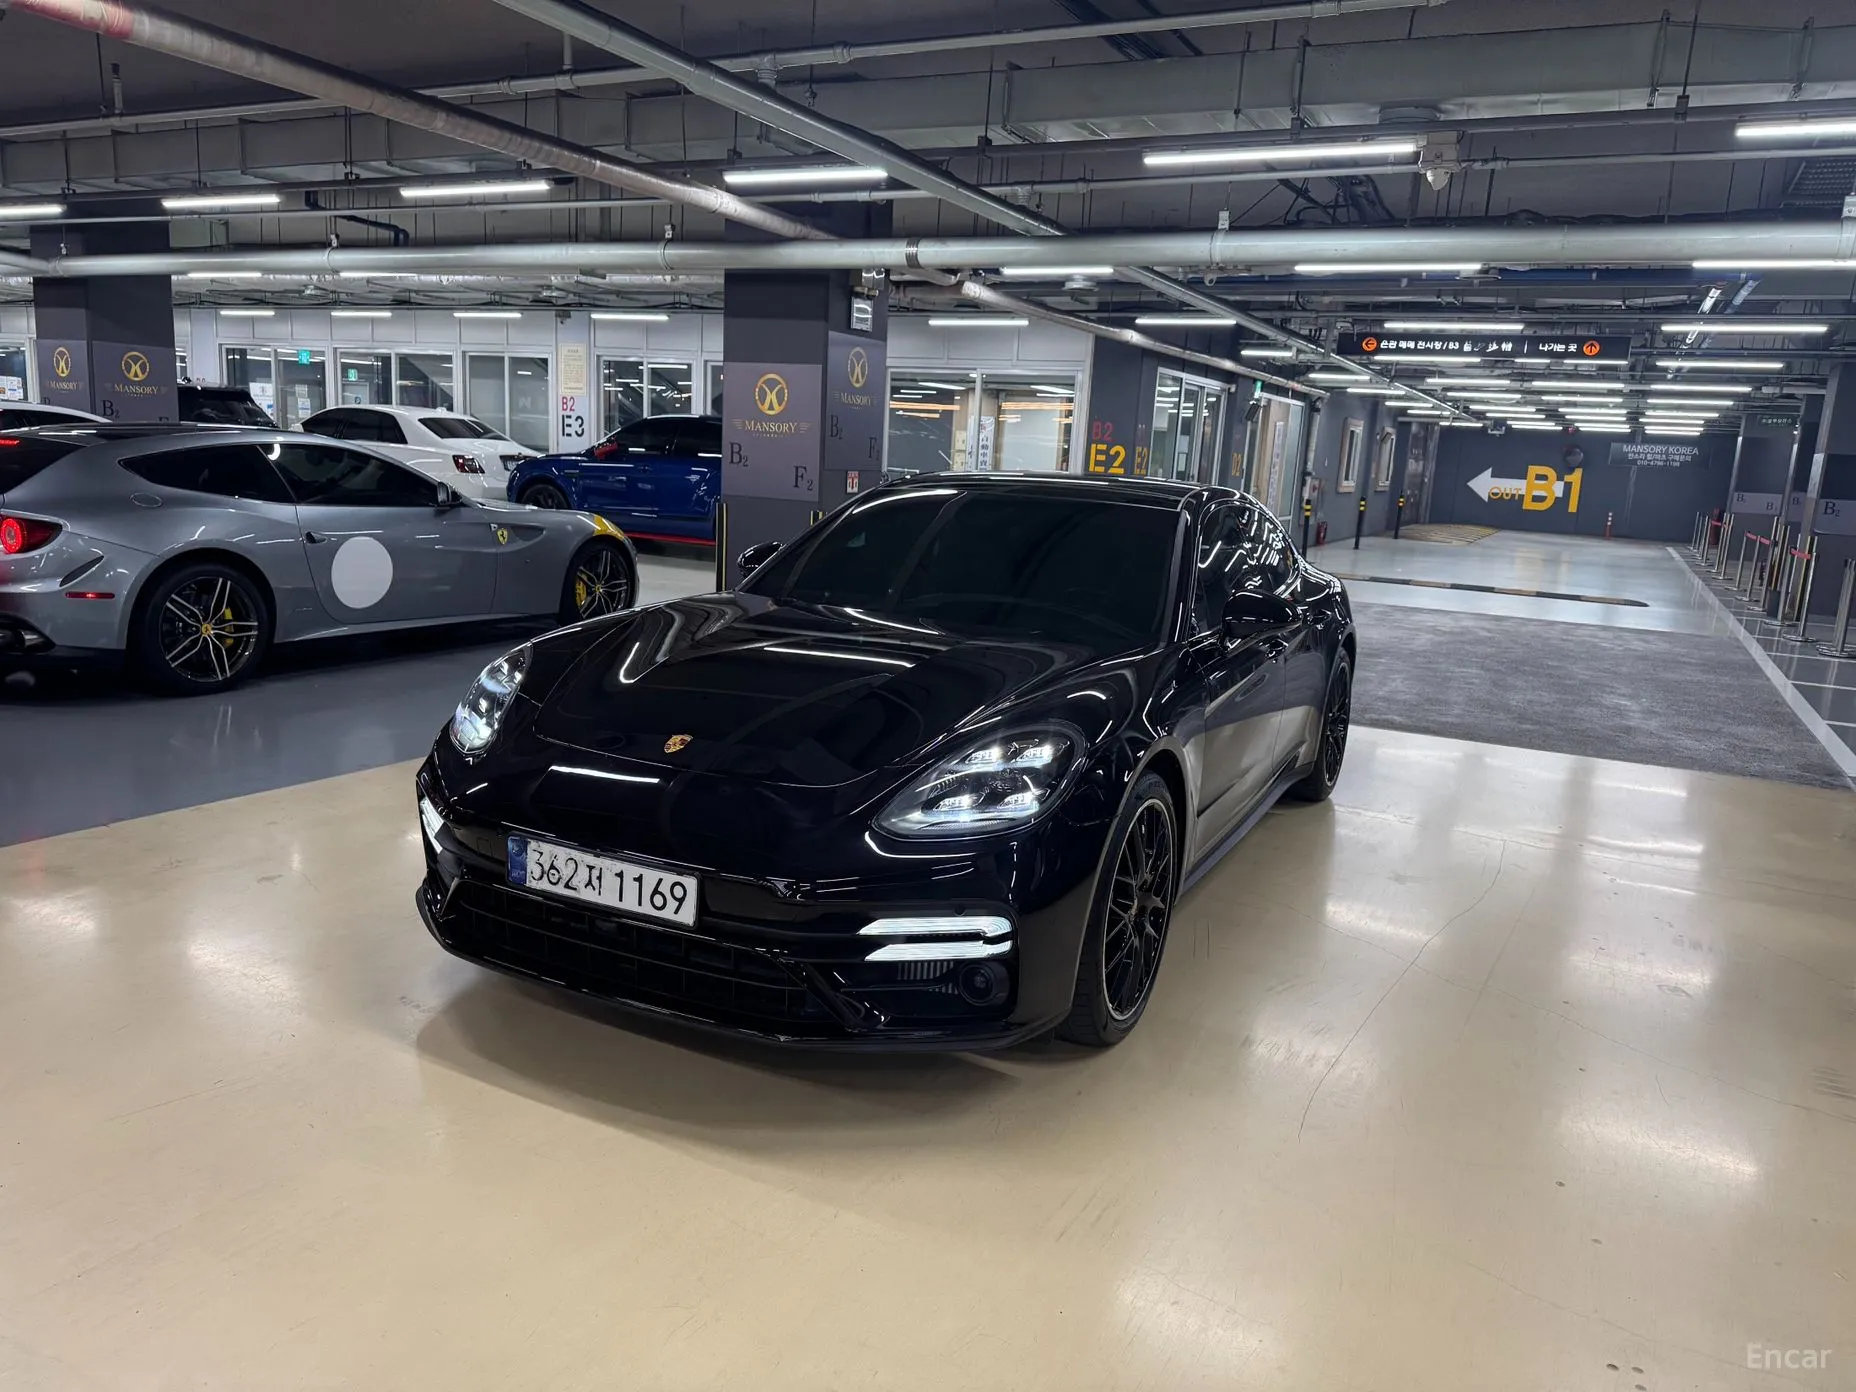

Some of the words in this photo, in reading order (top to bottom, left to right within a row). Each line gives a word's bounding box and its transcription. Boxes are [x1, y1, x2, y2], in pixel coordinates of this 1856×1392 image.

[1417, 340, 1442, 350] 전시장
[1539, 342, 1566, 352] 나가는
[1567, 343, 1578, 352] 곳
[49, 380, 79, 391] MANSORY
[115, 383, 159, 395] MANSORY
[102, 400, 120, 419] B2
[561, 396, 576, 412] B2
[561, 414, 585, 438] E3
[744, 419, 798, 434] MANSORY
[1092, 421, 1114, 442] B2
[728, 441, 749, 468] B2
[1088, 443, 1127, 475] E2
[1623, 444, 1668, 454] MANSORY
[1669, 446, 1699, 455] KOREA
[1133, 446, 1149, 475] E2
[793, 465, 814, 491] F2
[1489, 486, 1522, 500] OUT
[1522, 465, 1583, 513] B1
[614, 869, 688, 915] 1169
